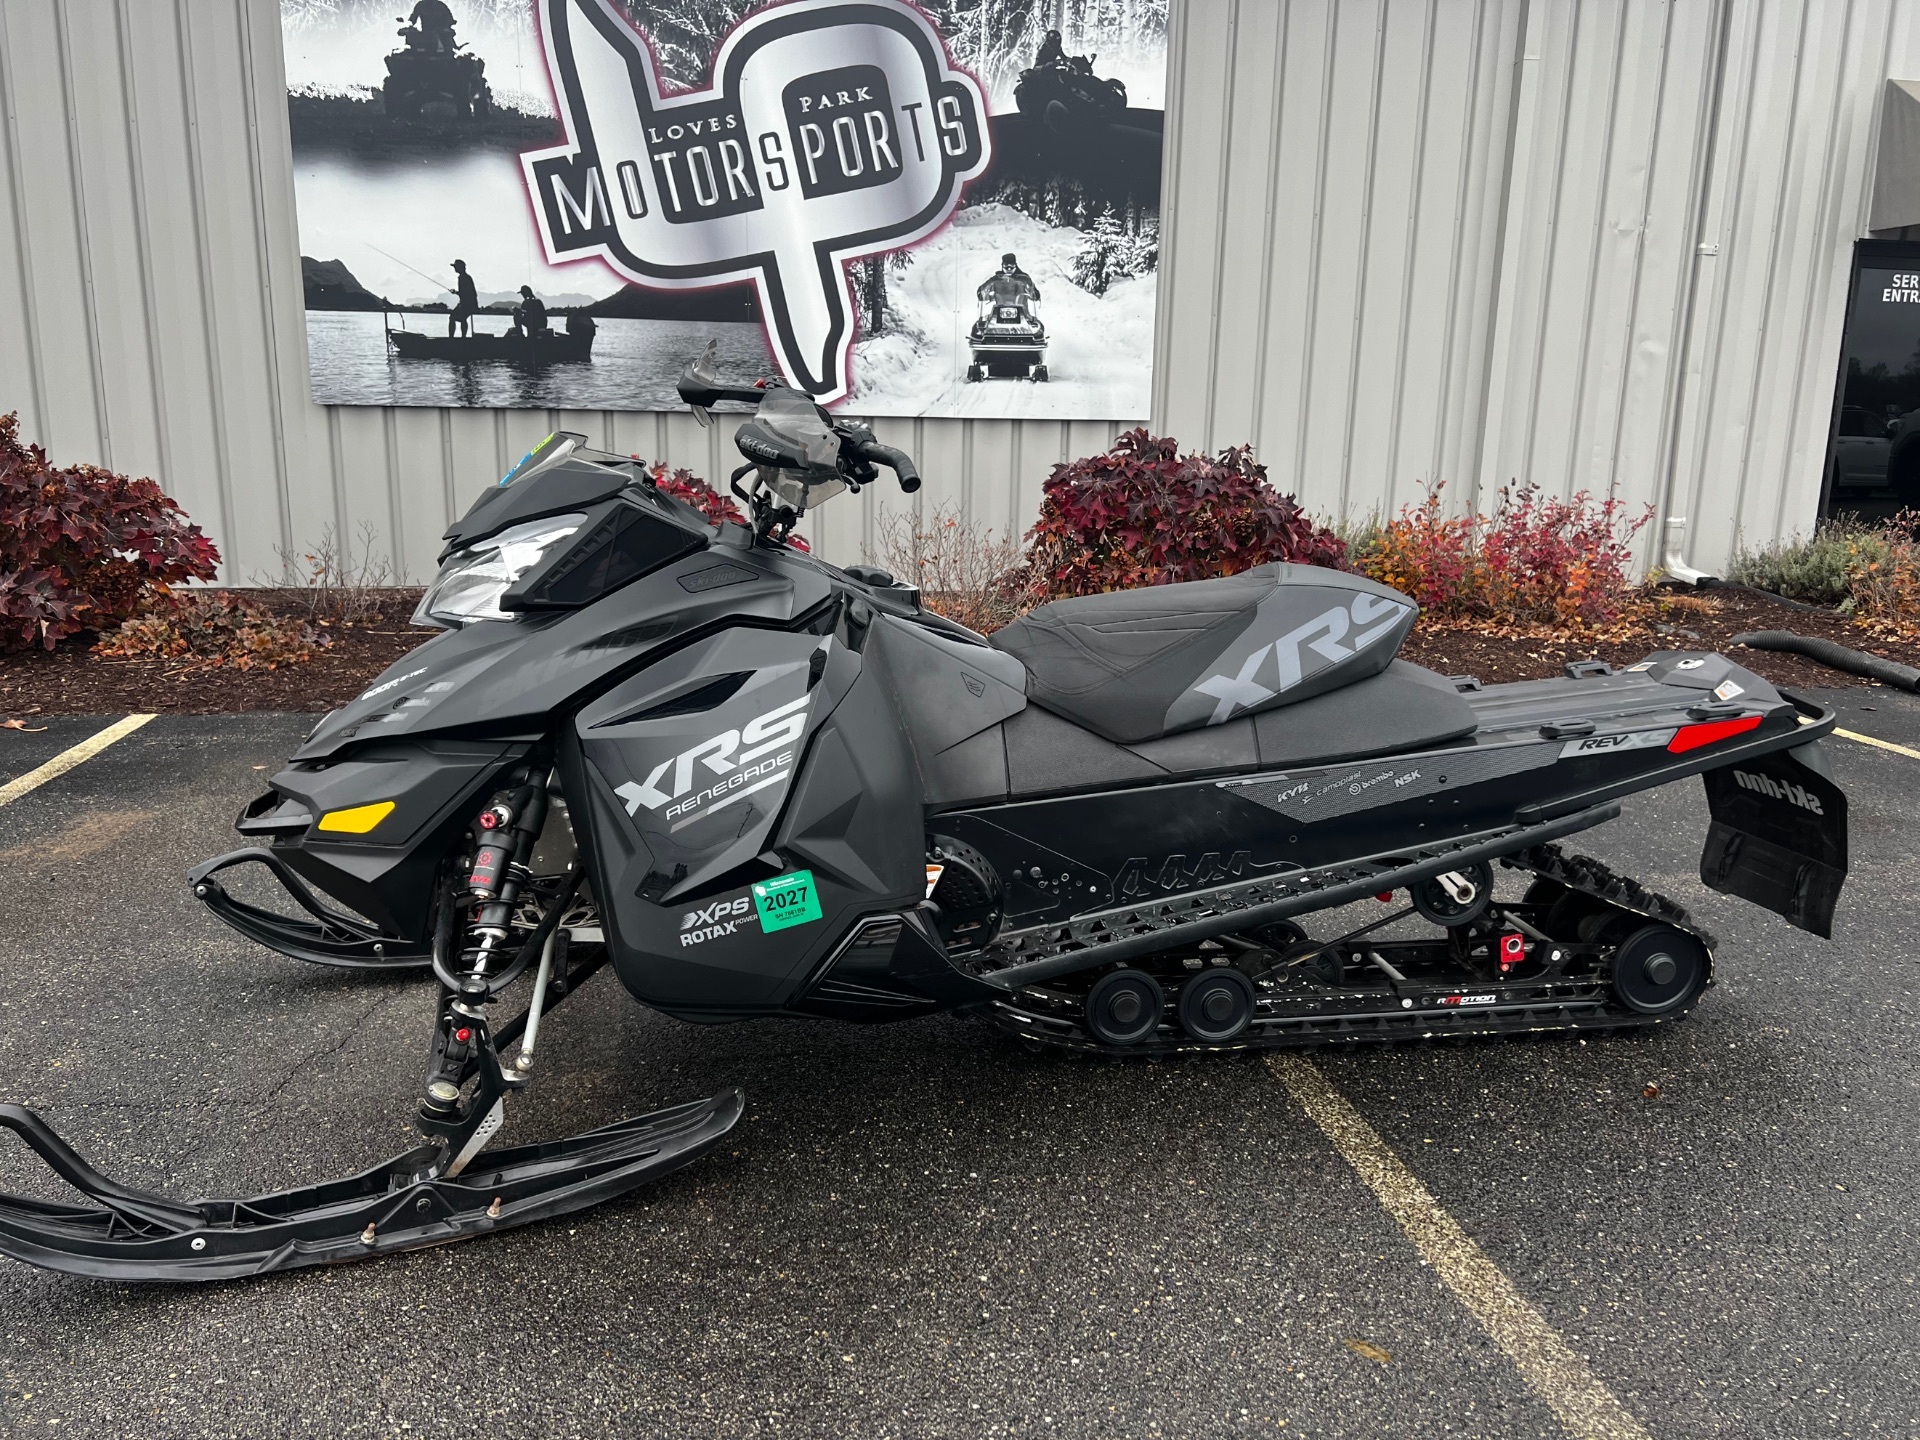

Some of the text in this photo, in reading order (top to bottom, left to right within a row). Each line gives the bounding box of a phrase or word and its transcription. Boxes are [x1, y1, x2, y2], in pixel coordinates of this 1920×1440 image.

[648, 86, 873, 144] LOVES PARK
[549, 95, 969, 235] MOTORSPORTS
[1882, 288, 1920, 303] ENTR
[1891, 274, 1920, 288] SER
[1193, 592, 1411, 726] XRS
[614, 693, 811, 817] XRS
[665, 750, 793, 820] RENEGADE
[1394, 769, 1421, 787] NSK
[694, 897, 750, 926] XPS
[763, 886, 808, 912] 2027
[680, 920, 738, 947] ROTAX
[735, 913, 759, 926] POWER
